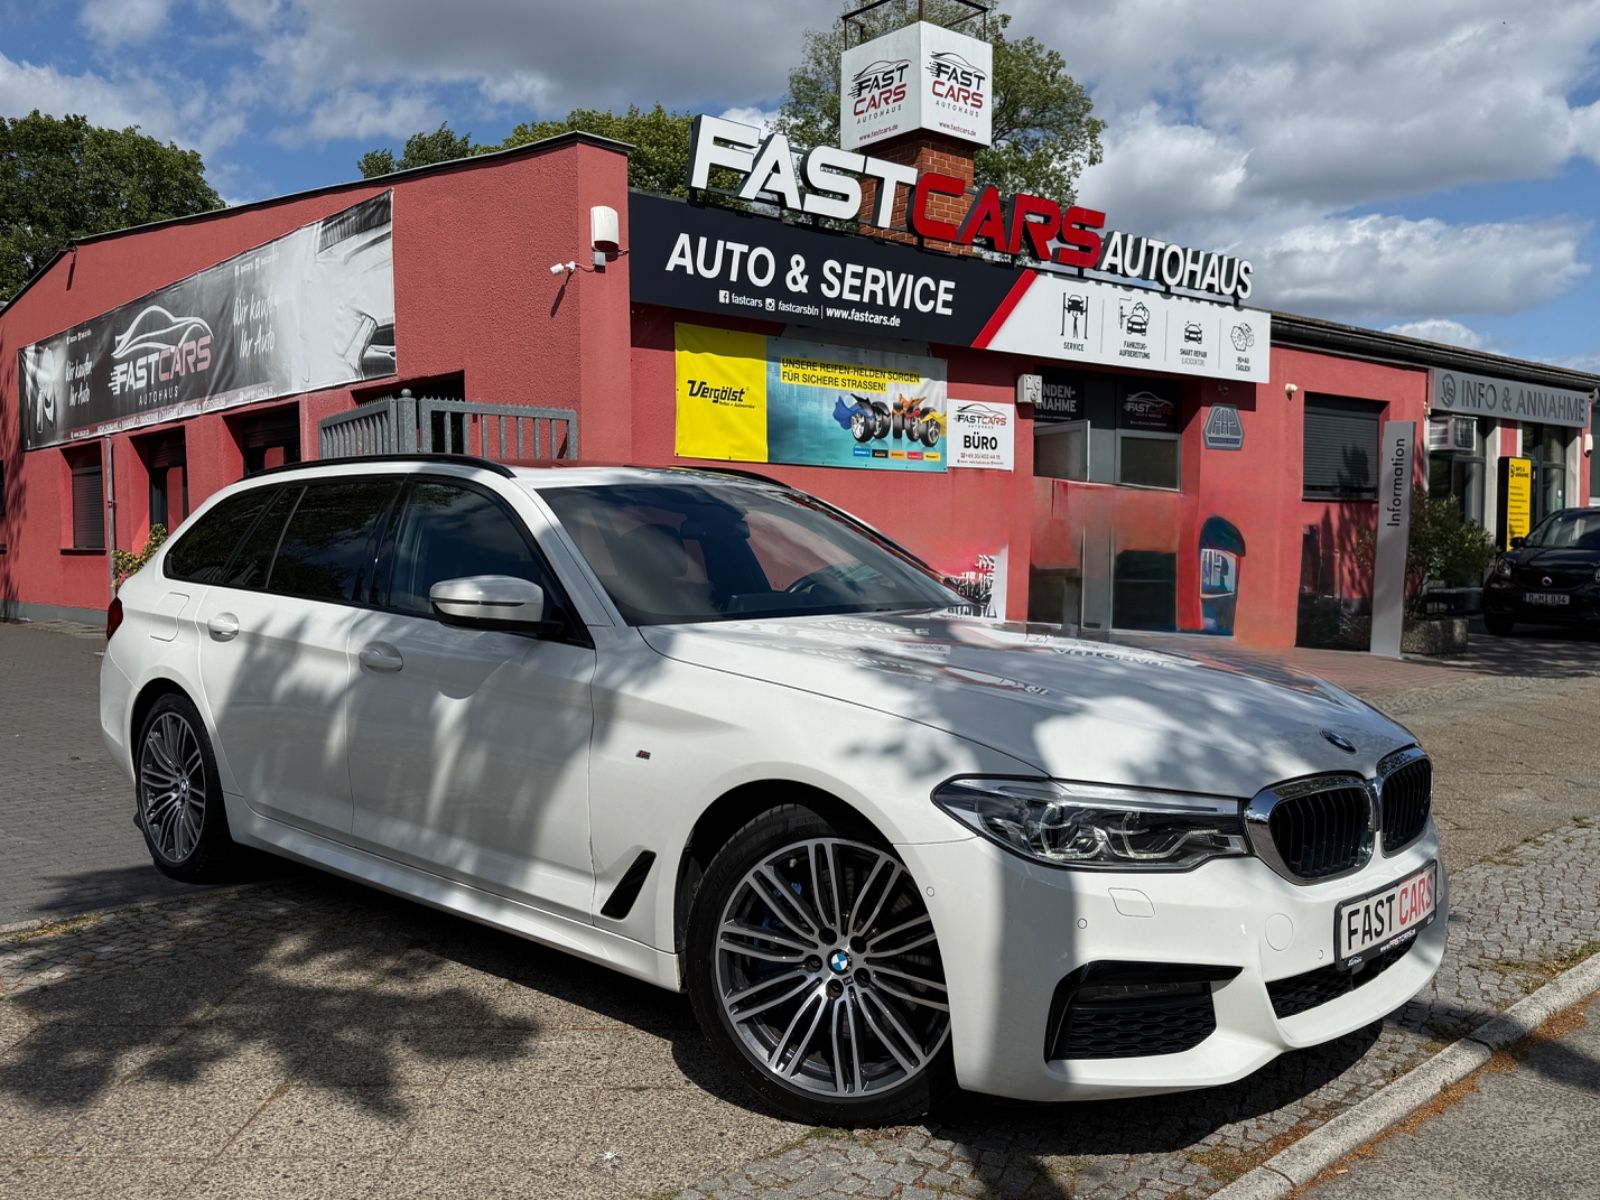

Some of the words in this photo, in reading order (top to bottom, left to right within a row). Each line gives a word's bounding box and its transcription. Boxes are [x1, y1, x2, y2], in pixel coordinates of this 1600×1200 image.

[857, 64, 909, 97] FAST
[937, 61, 985, 91] FAST
[853, 83, 907, 116] CARS
[932, 80, 983, 109] CARS
[857, 104, 902, 124] AUTOHAUS
[936, 101, 979, 118] AUTOHAUS
[859, 124, 899, 141] www.fastcars.de
[939, 121, 977, 136] www.fastcars.de
[665, 232, 776, 287] AUTO
[785, 254, 809, 293] &
[820, 259, 956, 316] SERVICE
[1101, 231, 1253, 299] AUTOHAUS
[731, 292, 763, 308] fastcars
[778, 300, 819, 316] fastcarsbln
[826, 306, 901, 327] www.fastcars.de
[1063, 341, 1085, 352] SERVICE
[782, 358, 817, 371] UNSERE
[820, 363, 886, 378] REIFEN-HELDEN
[887, 371, 920, 383] SORGEN
[782, 370, 800, 382] FÜR
[802, 373, 839, 386] SICHERE
[841, 379, 886, 391] STRASSEN!
[138, 385, 179, 406] AUTOHAUS
[687, 379, 746, 404] Vergölst
[1461, 380, 1497, 410] INFO
[1501, 386, 1512, 413] &
[1515, 389, 1585, 422] ANNAHME
[963, 431, 998, 450] BÜRO
[1386, 438, 1405, 527] Information
[1347, 893, 1396, 951] FAST
[1399, 872, 1433, 926] CARS
